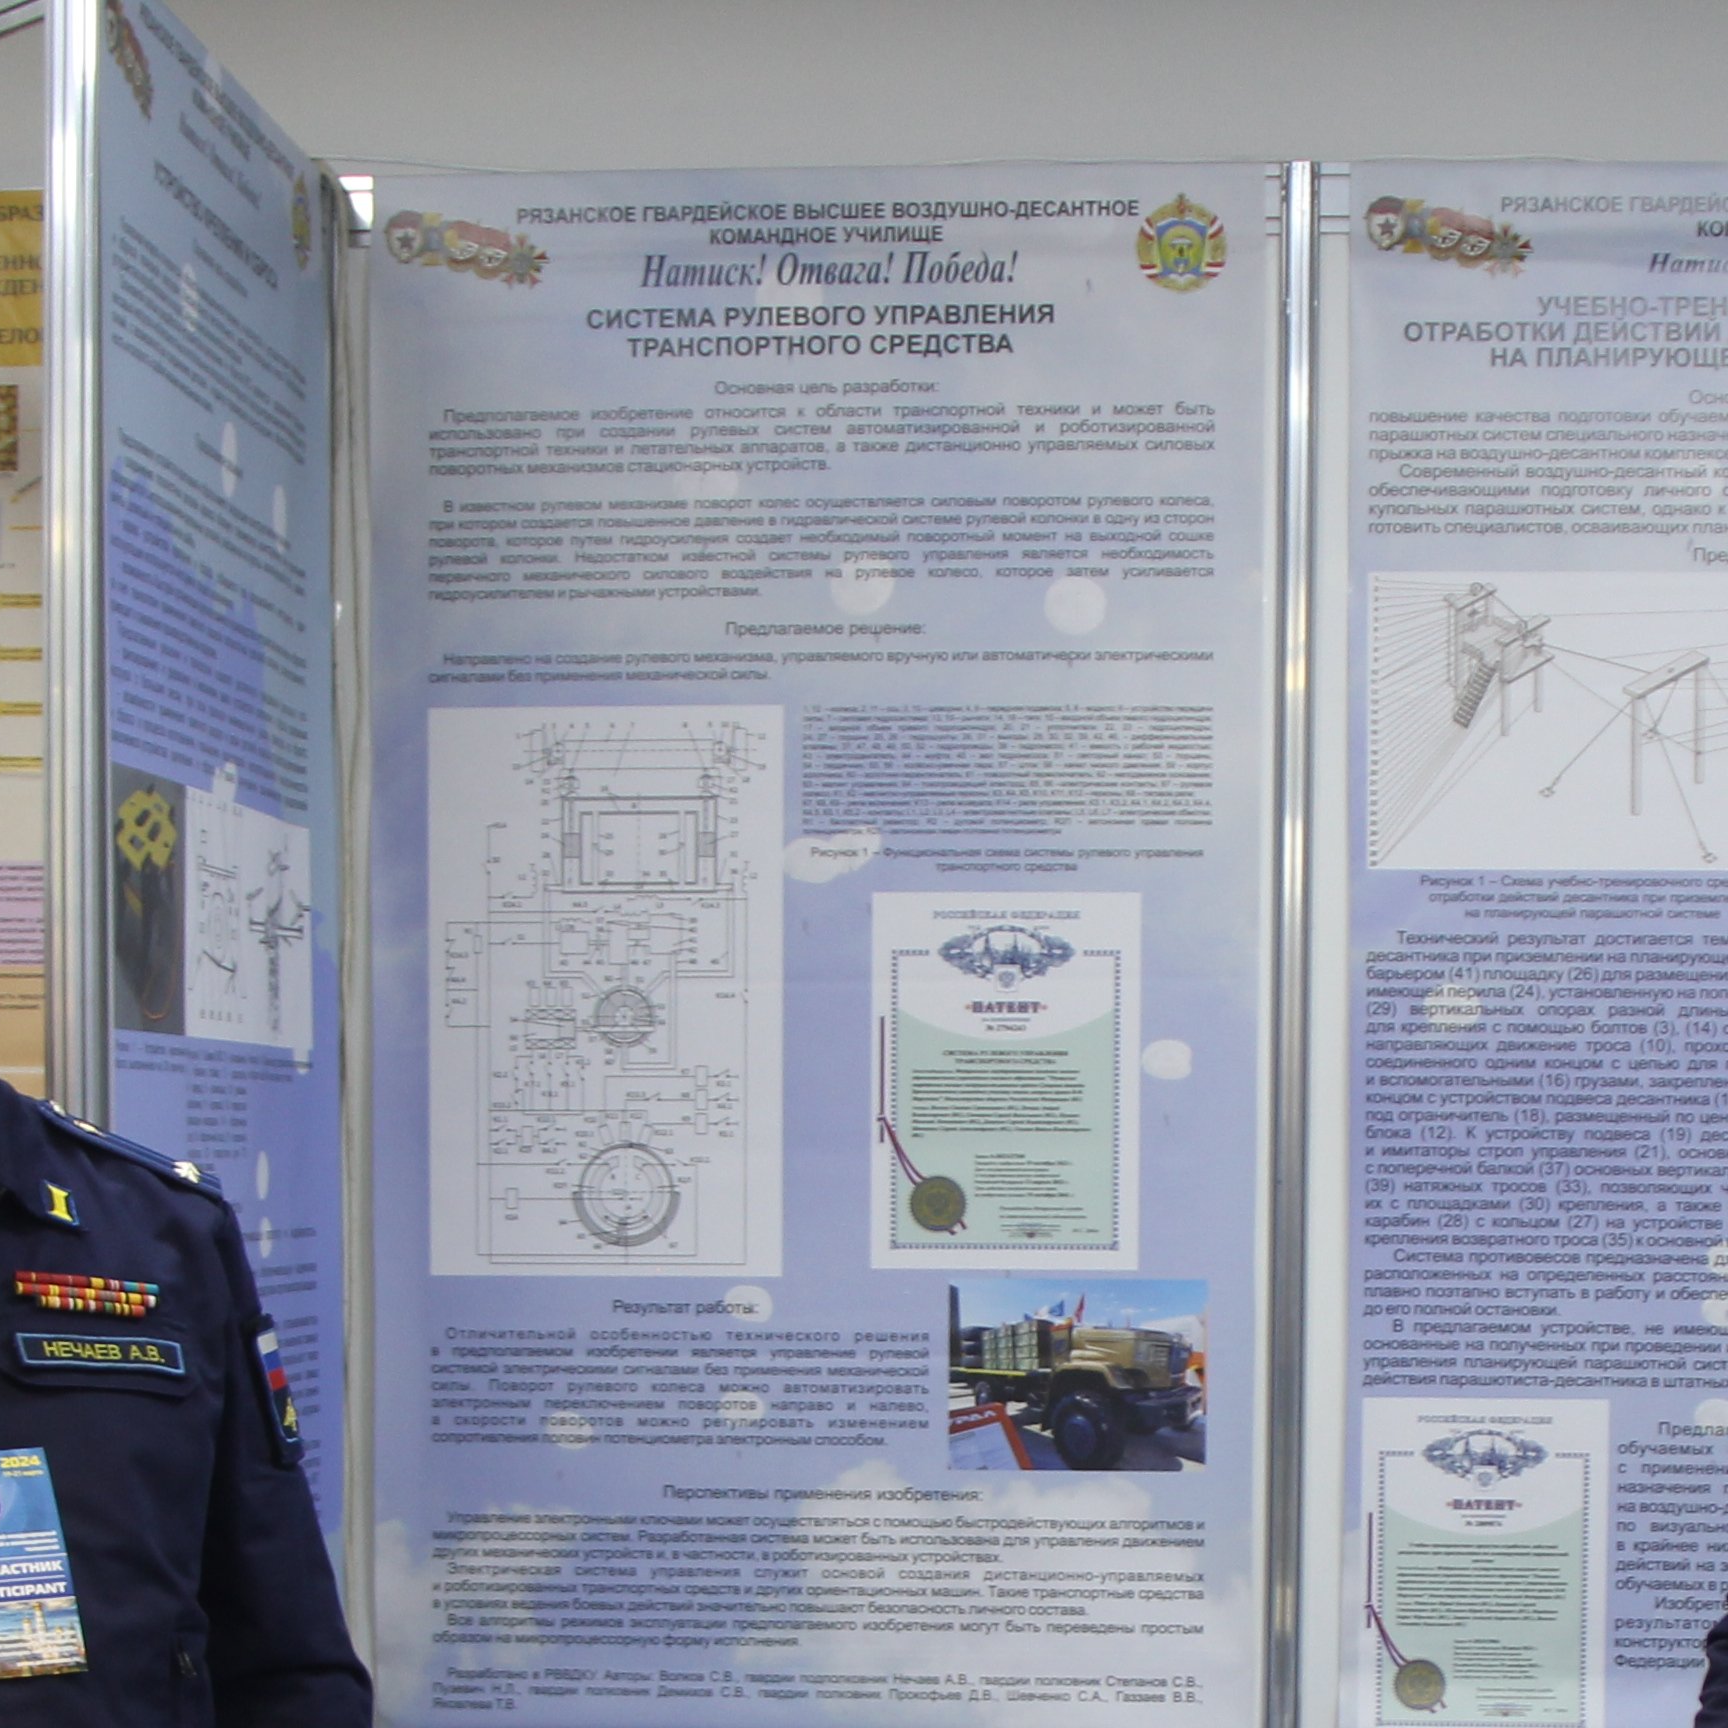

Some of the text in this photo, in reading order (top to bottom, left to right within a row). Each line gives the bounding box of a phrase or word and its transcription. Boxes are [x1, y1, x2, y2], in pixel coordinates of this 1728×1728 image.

[517, 199, 1140, 224] РЯЗАНСКОЕ ГВАРДЕЙСКОЕ ВЫСШЕЕ ВОЗДУШНО-ДЕСАНТНОЕ
[1500, 195, 1624, 214] РЯЗАНСКОЕ
[709, 224, 945, 245] КОМАНДНОЕ УЧИЛИЩЕ
[641, 250, 1019, 287] Натиск! Отвага! Победа!
[586, 303, 1055, 329] СИСТЕМА РУЛЕВОГО УПРАВЛЕНИЯ
[1403, 320, 1565, 342] ОТРАБОТКИ
[1572, 321, 1720, 343] ДЕЙСТВИЙ
[626, 332, 1014, 357] ТРАНСПОРТНОГО СРЕДСТВА
[1489, 346, 1528, 367] НА
[713, 378, 940, 396] Основная цель разработки:
[724, 620, 926, 637] Предлагаемое решение:
[612, 1298, 760, 1316] Результат работы:
[42, 1341, 166, 1363] НЕЧАЕВ А.В.
[1616, 1440, 1714, 1457] обучаемых
[663, 1484, 984, 1502] Перспективы применения изобретения:
[1615, 1520, 1637, 1532] по
[1632, 1538, 1700, 1553] крайнее
[1614, 1654, 1706, 1669] Федерации
